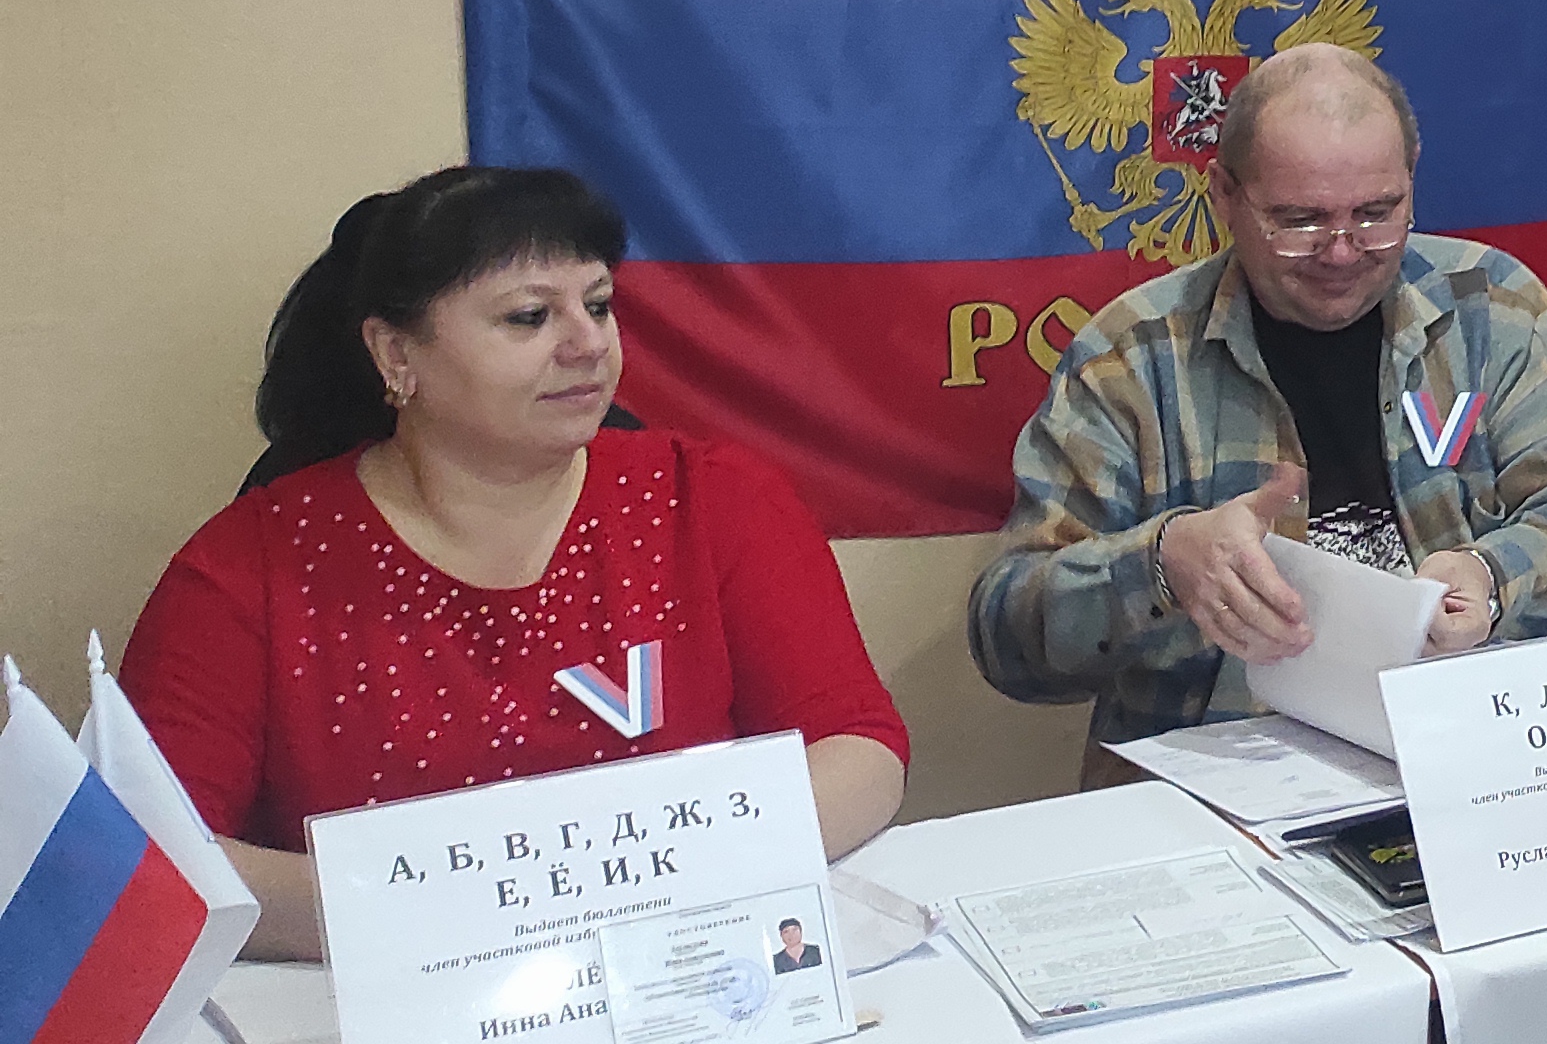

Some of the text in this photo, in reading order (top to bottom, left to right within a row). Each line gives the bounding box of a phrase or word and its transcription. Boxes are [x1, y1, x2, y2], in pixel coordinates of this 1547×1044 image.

[1491, 692, 1521, 718] К,
[1471, 790, 1499, 805] член
[388, 791, 761, 885] А, Б, В, Г, Д, Ж, З,
[496, 877, 531, 909] Е,
[549, 861, 583, 898] Ё,
[514, 896, 672, 937] Выдает бюллетени
[420, 955, 460, 975] член
[463, 933, 562, 970] участковой
[479, 998, 609, 1041] Инна Ана
